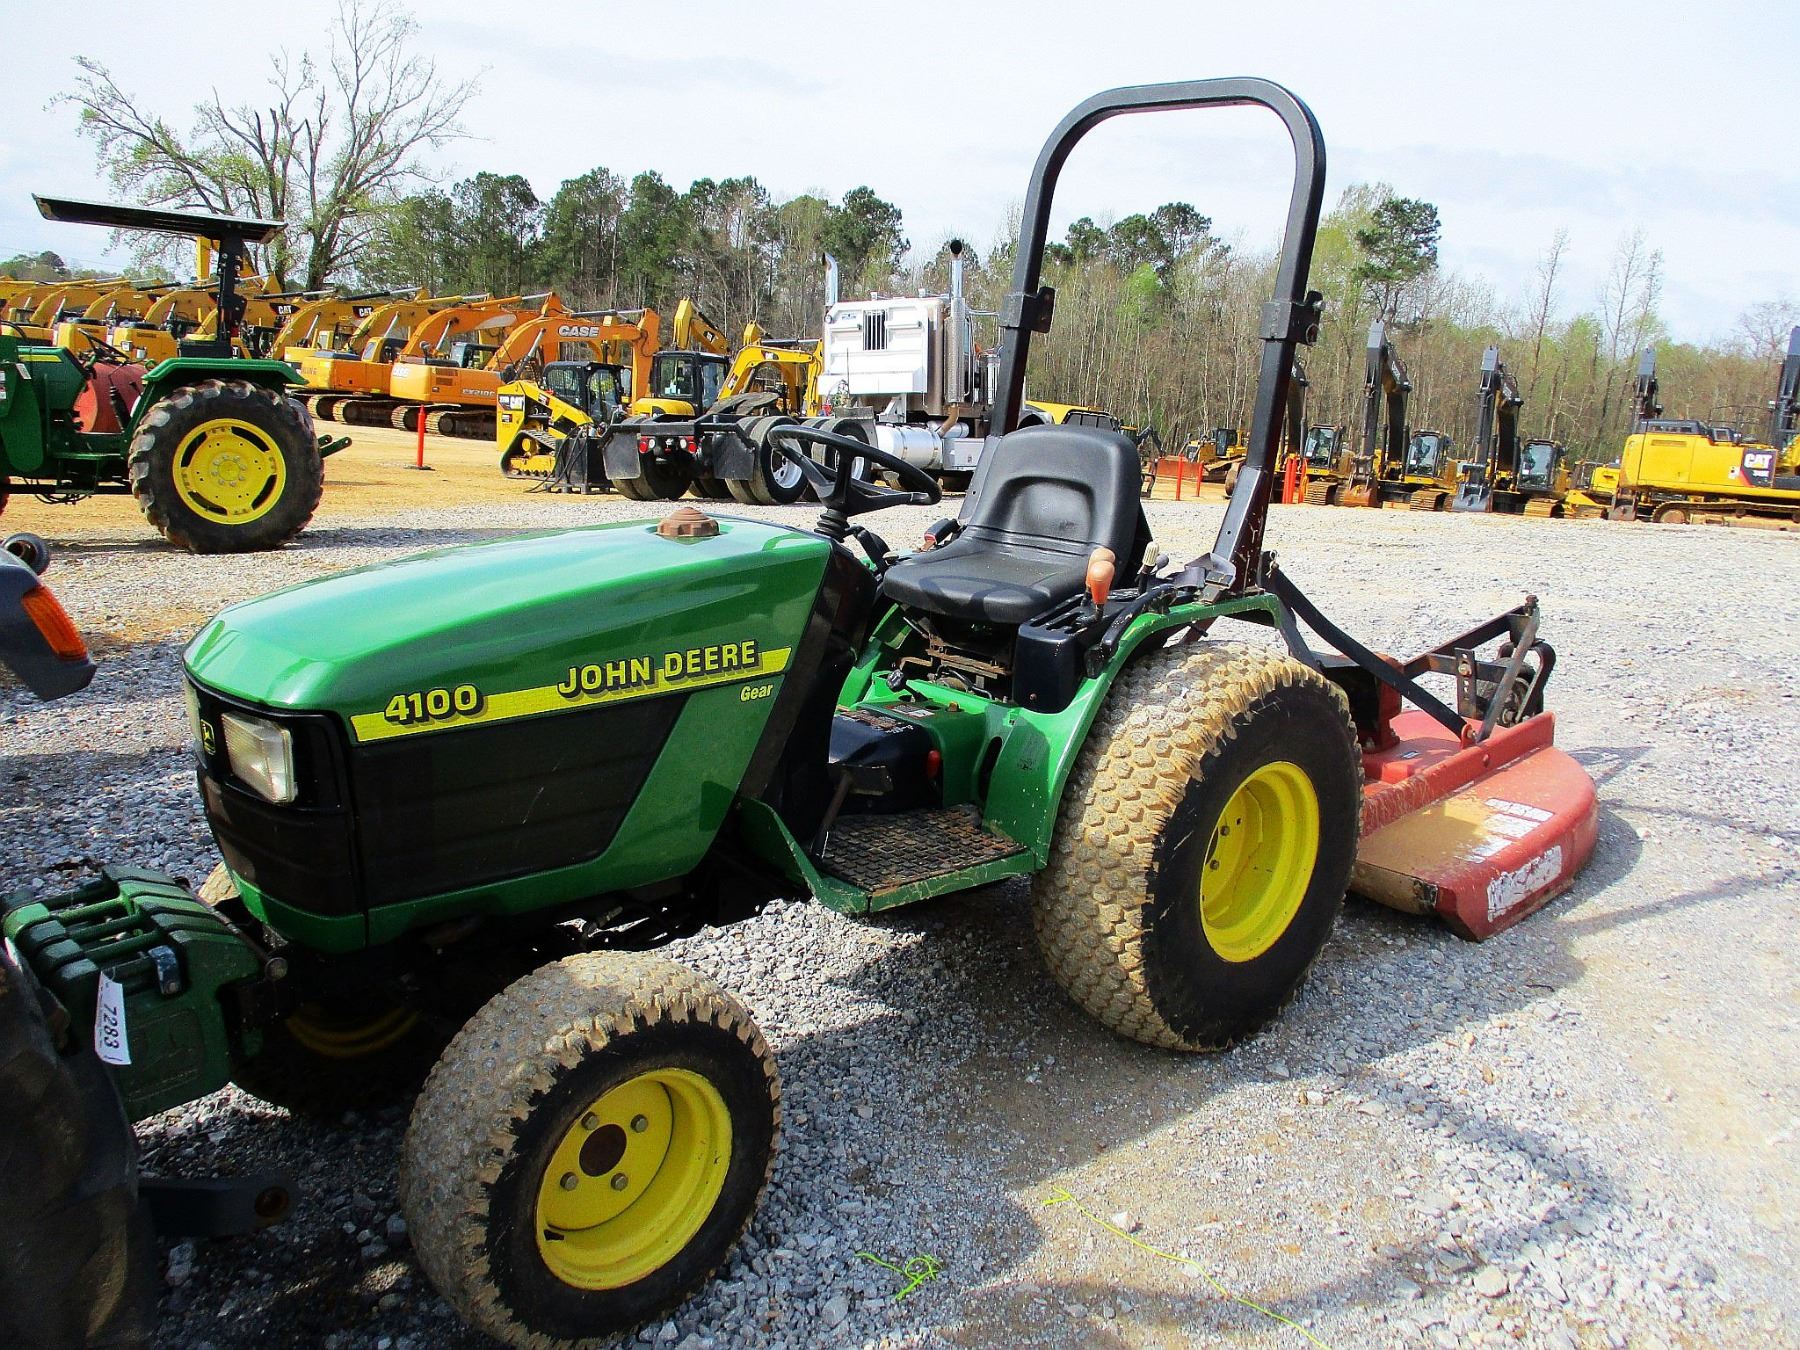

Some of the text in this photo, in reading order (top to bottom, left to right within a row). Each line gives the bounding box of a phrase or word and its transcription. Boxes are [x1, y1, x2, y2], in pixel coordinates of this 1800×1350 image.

[278, 304, 292, 315] CAT
[558, 324, 600, 337] CASE
[509, 394, 524, 411] CAT
[1744, 453, 1772, 469] CAT
[557, 638, 760, 699] JOHN DEERE
[740, 683, 775, 703] Gear
[384, 683, 484, 725] 4100
[103, 1003, 119, 1049] 7283
